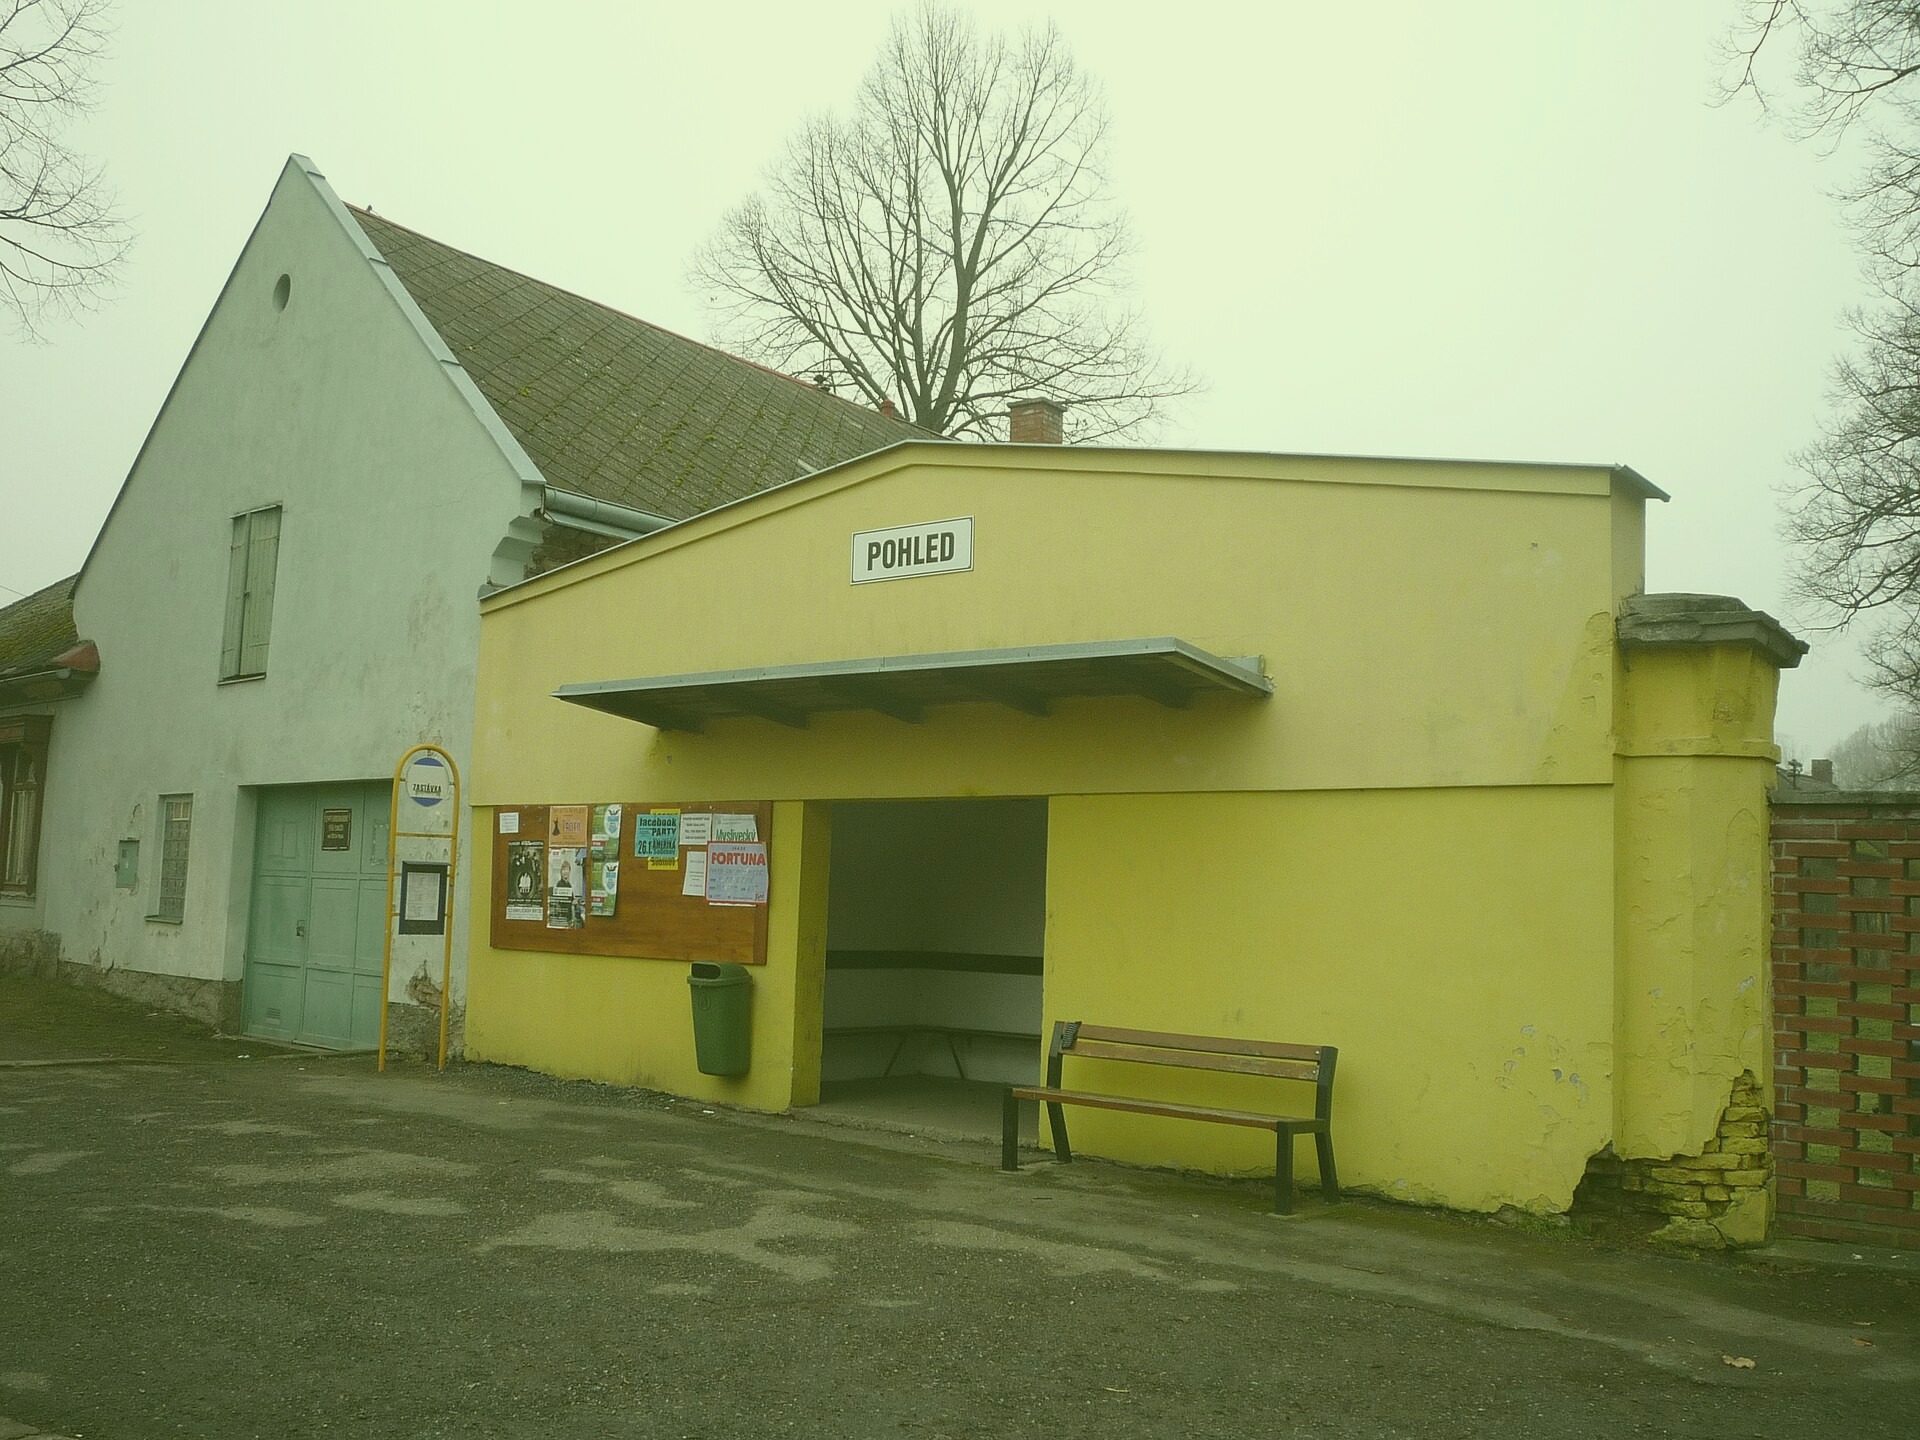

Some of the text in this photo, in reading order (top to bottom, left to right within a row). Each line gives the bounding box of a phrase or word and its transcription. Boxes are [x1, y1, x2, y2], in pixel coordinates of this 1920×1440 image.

[867, 531, 955, 571] POHLED
[412, 783, 442, 793] ZASTÁVKA
[639, 817, 677, 827] facebook
[651, 827, 677, 837] PARTY
[711, 851, 766, 866] FORTUNA
